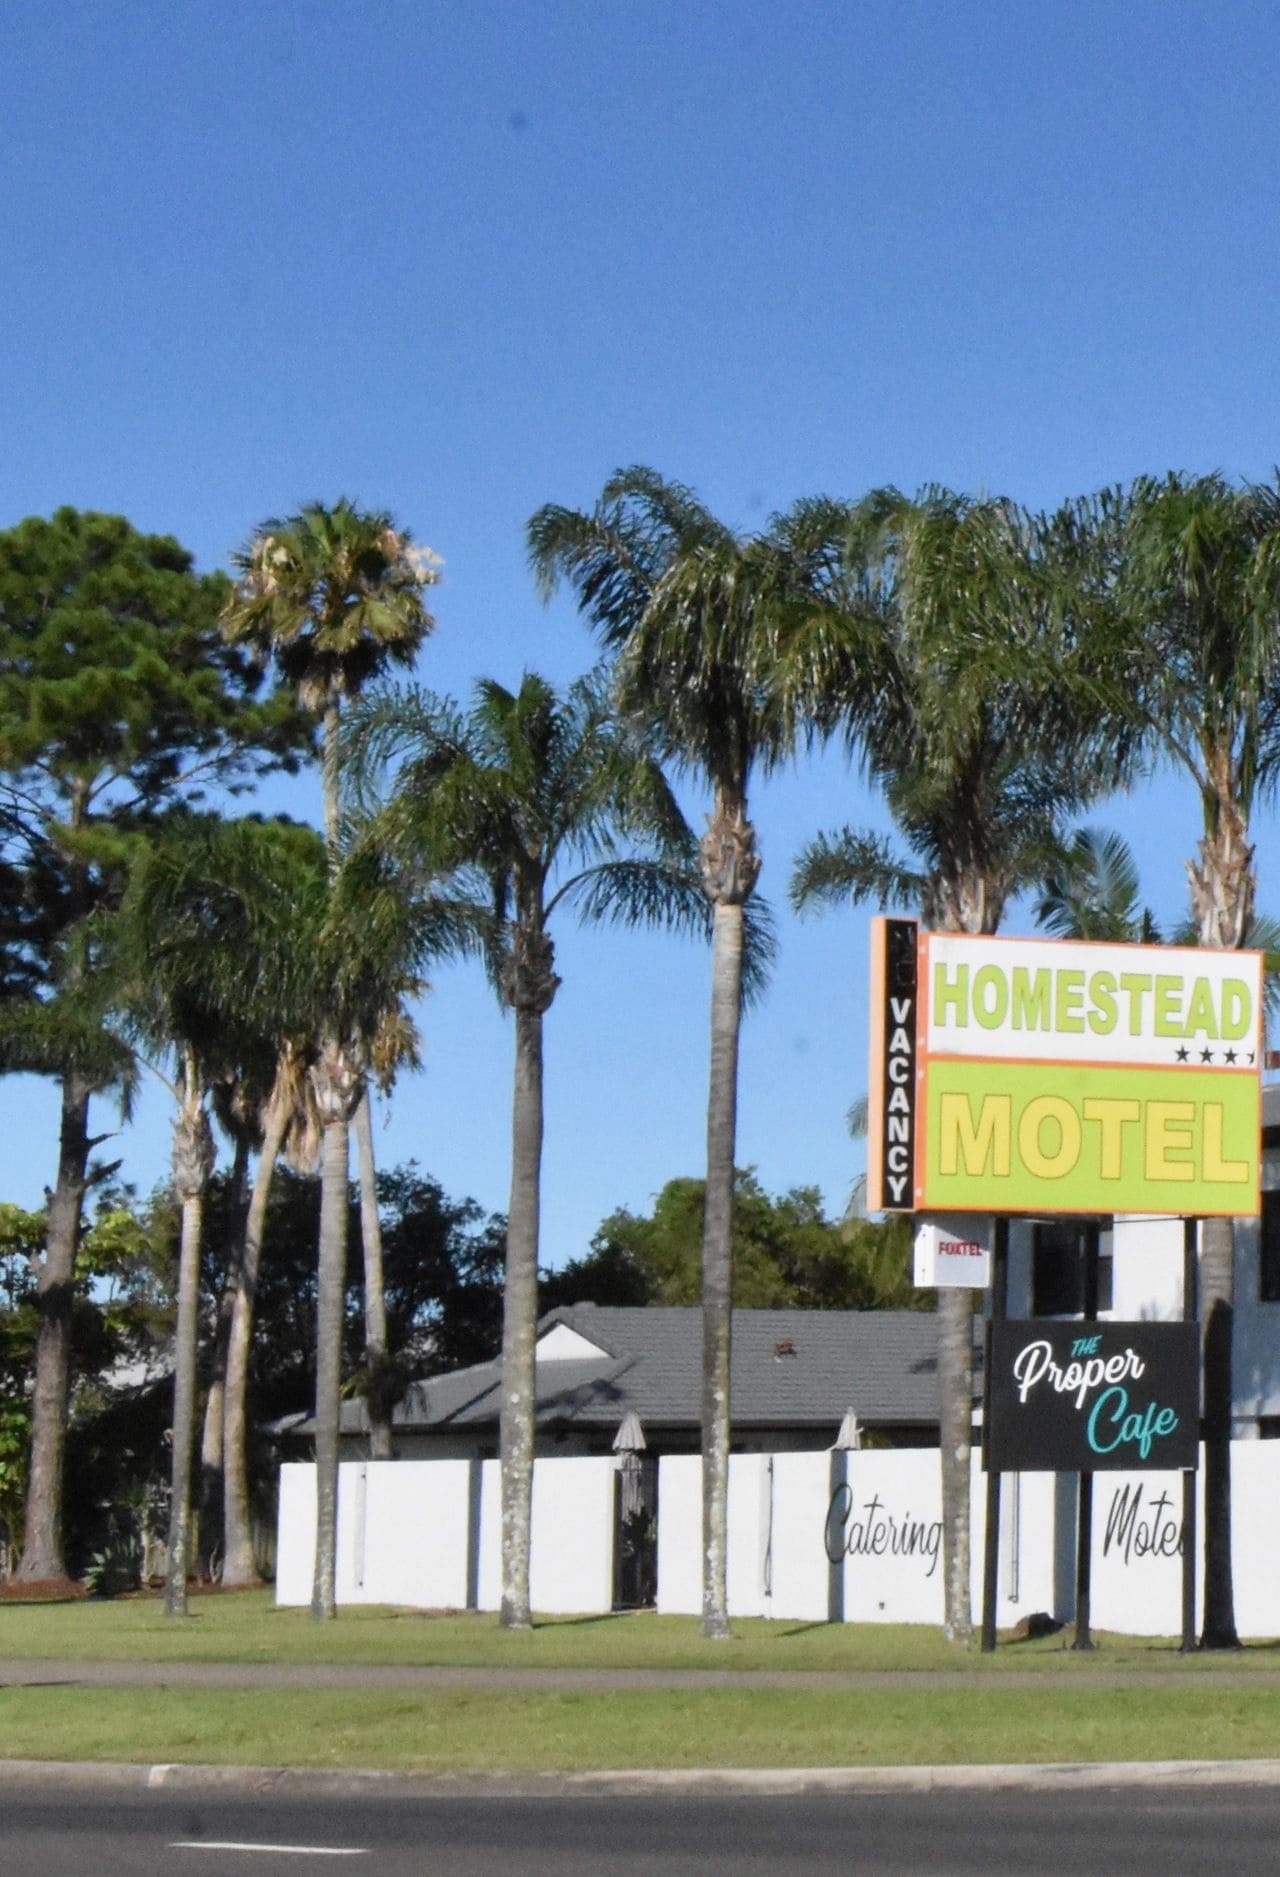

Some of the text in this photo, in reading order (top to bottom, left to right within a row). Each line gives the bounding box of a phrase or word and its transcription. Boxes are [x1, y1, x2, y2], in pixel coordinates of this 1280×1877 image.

[933, 962, 1253, 1041] HOMESTEAD
[888, 997, 912, 1203] VACANCY
[939, 1091, 1250, 1184] MOTEL
[938, 1241, 983, 1257] FOXTEL
[1013, 1340, 1146, 1410] Proper
[1071, 1334, 1104, 1358] THE
[1087, 1386, 1179, 1460] Cafe
[824, 1482, 944, 1578] Catering
